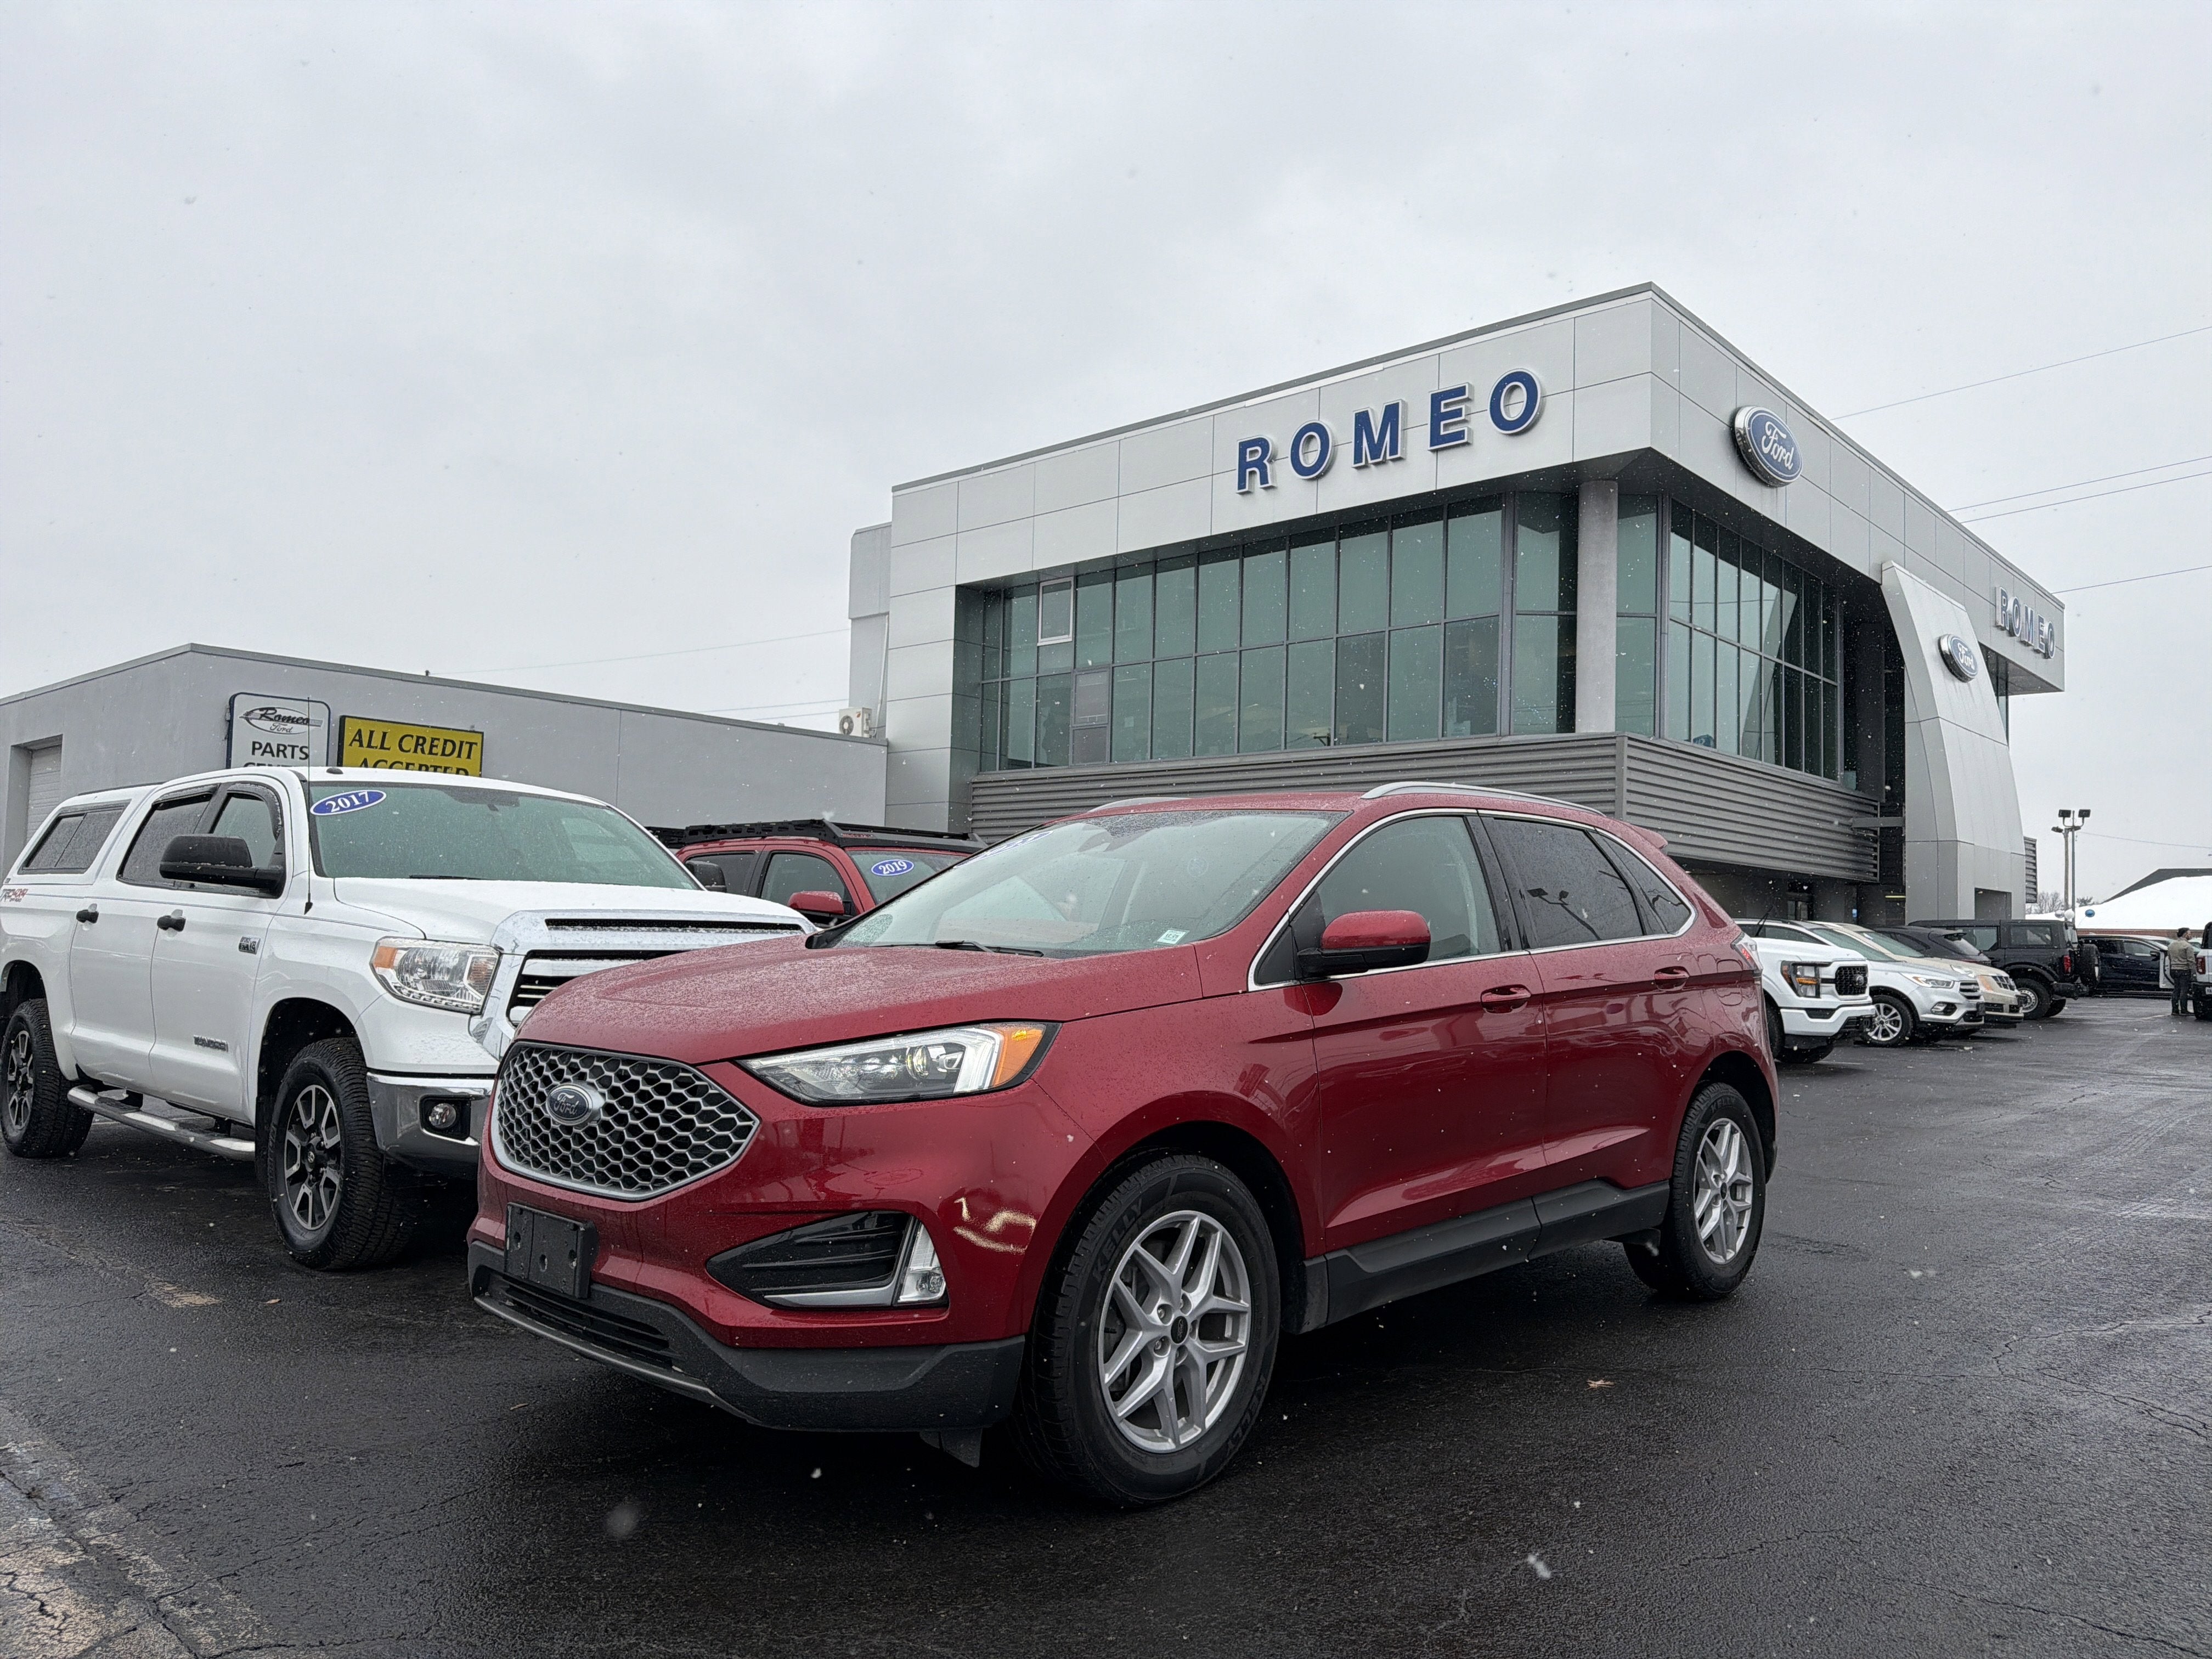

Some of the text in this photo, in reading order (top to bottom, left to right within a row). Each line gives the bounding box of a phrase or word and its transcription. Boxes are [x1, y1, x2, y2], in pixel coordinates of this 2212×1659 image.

[1237, 369, 1541, 494] ROMEO
[1762, 421, 1795, 470] Ford
[1997, 587, 2055, 658] ROMEO
[1957, 642, 1975, 670] Ford
[249, 707, 309, 725] Romeo
[270, 723, 293, 733] Ford
[251, 741, 309, 760] PARTS
[348, 728, 478, 760] ALL CREDIT
[325, 791, 370, 812] 2017
[878, 860, 907, 874] 2019
[554, 1092, 579, 1115] Ford
[1093, 1197, 1142, 1283] KELLY
